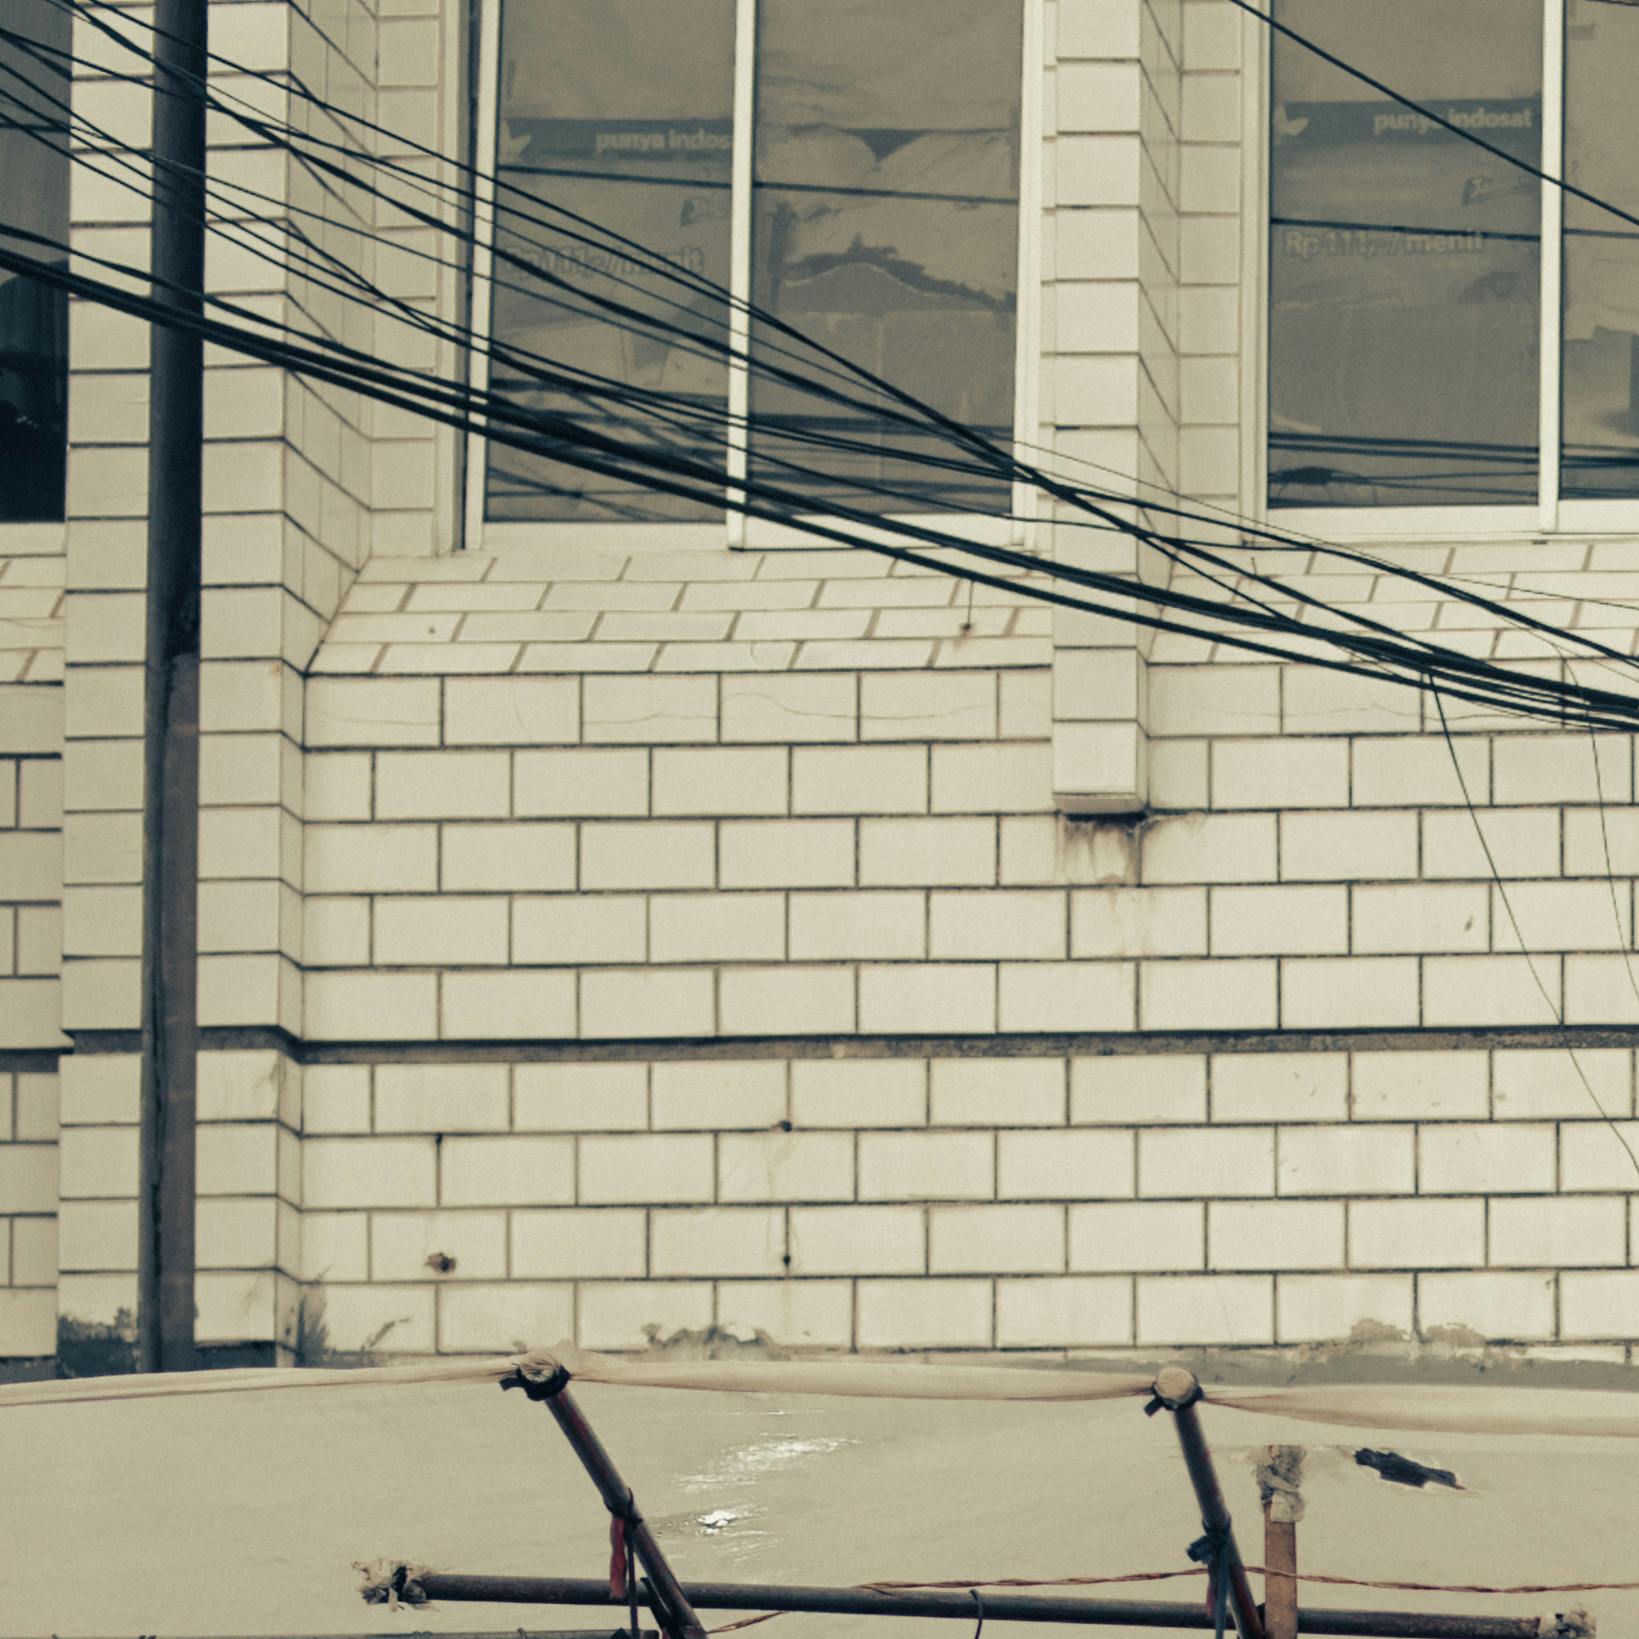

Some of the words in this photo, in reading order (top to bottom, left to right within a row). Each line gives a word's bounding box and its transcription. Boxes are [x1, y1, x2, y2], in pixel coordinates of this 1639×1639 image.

[1450, 108, 1532, 128] indosat
[596, 132, 664, 154] punya
[669, 128, 731, 149] indos
